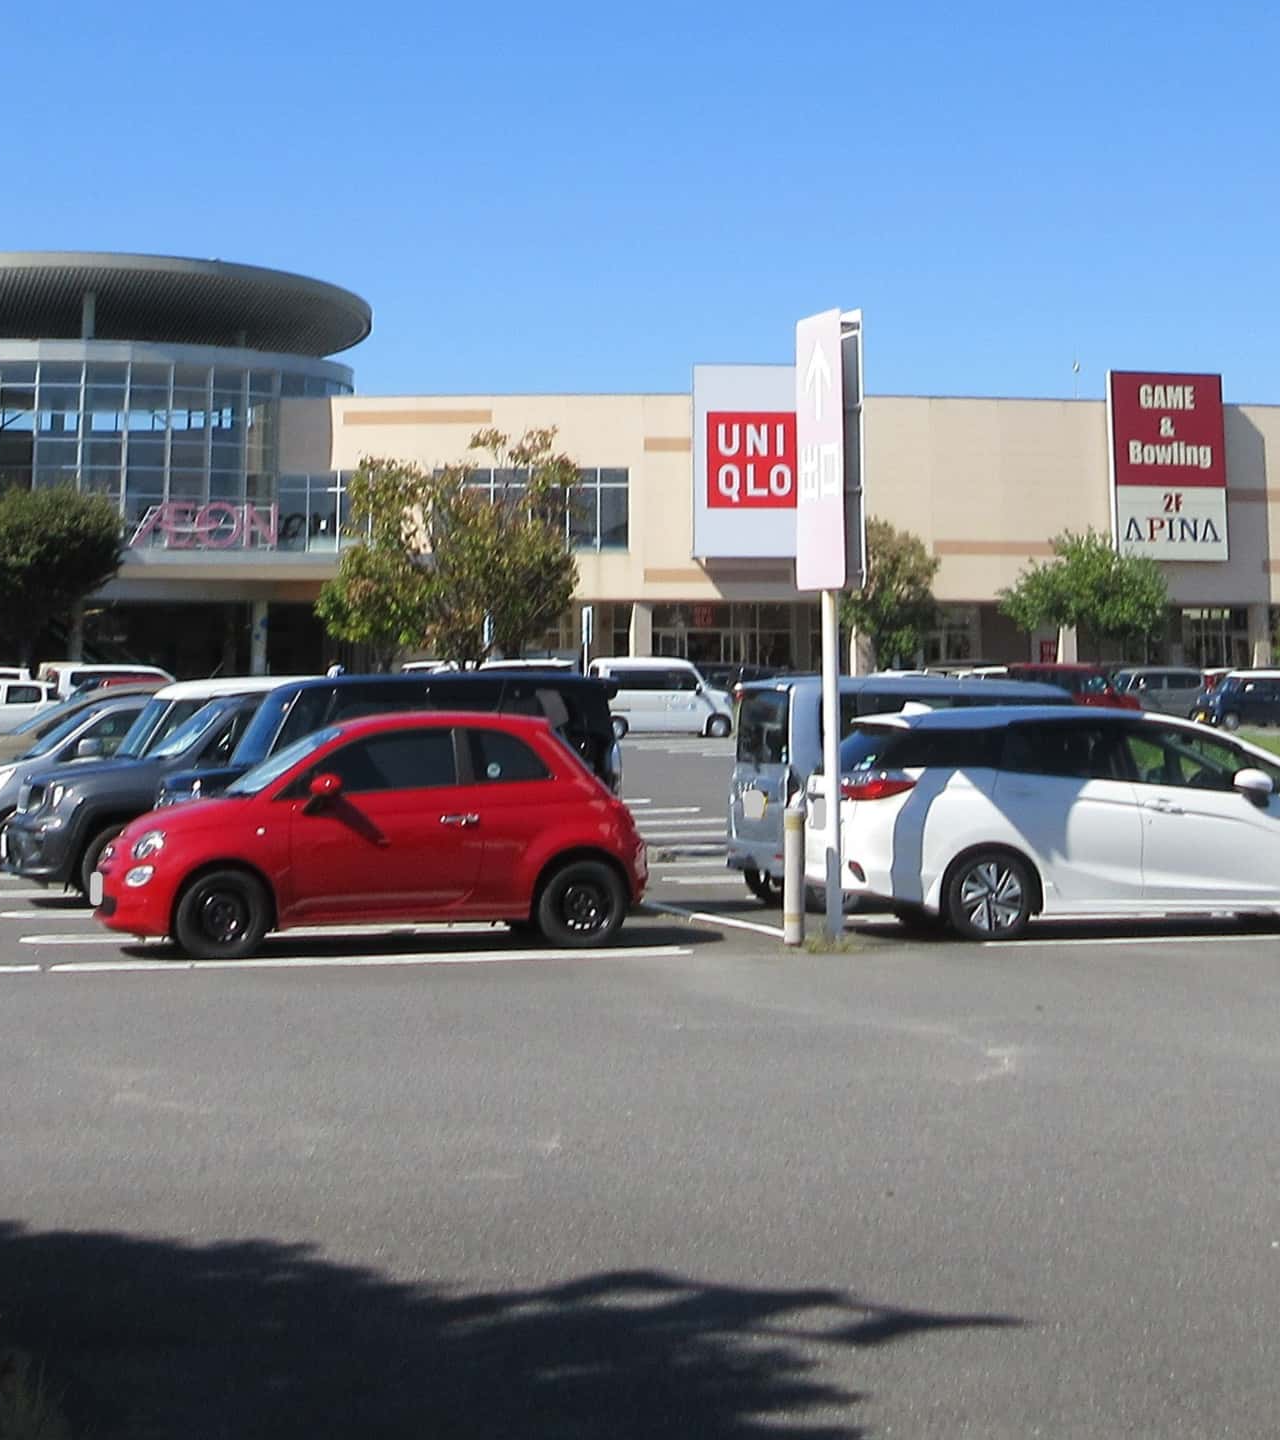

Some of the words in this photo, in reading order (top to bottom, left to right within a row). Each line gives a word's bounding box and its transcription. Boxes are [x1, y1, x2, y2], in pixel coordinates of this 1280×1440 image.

[1139, 384, 1195, 410] GAME
[718, 423, 785, 457] UNI
[1159, 416, 1176, 438] &
[1128, 440, 1212, 469] Bowling
[718, 463, 792, 502] QLO
[800, 442, 840, 503] 出口
[1163, 493, 1183, 513] 2F
[1124, 517, 1221, 544] APINA
